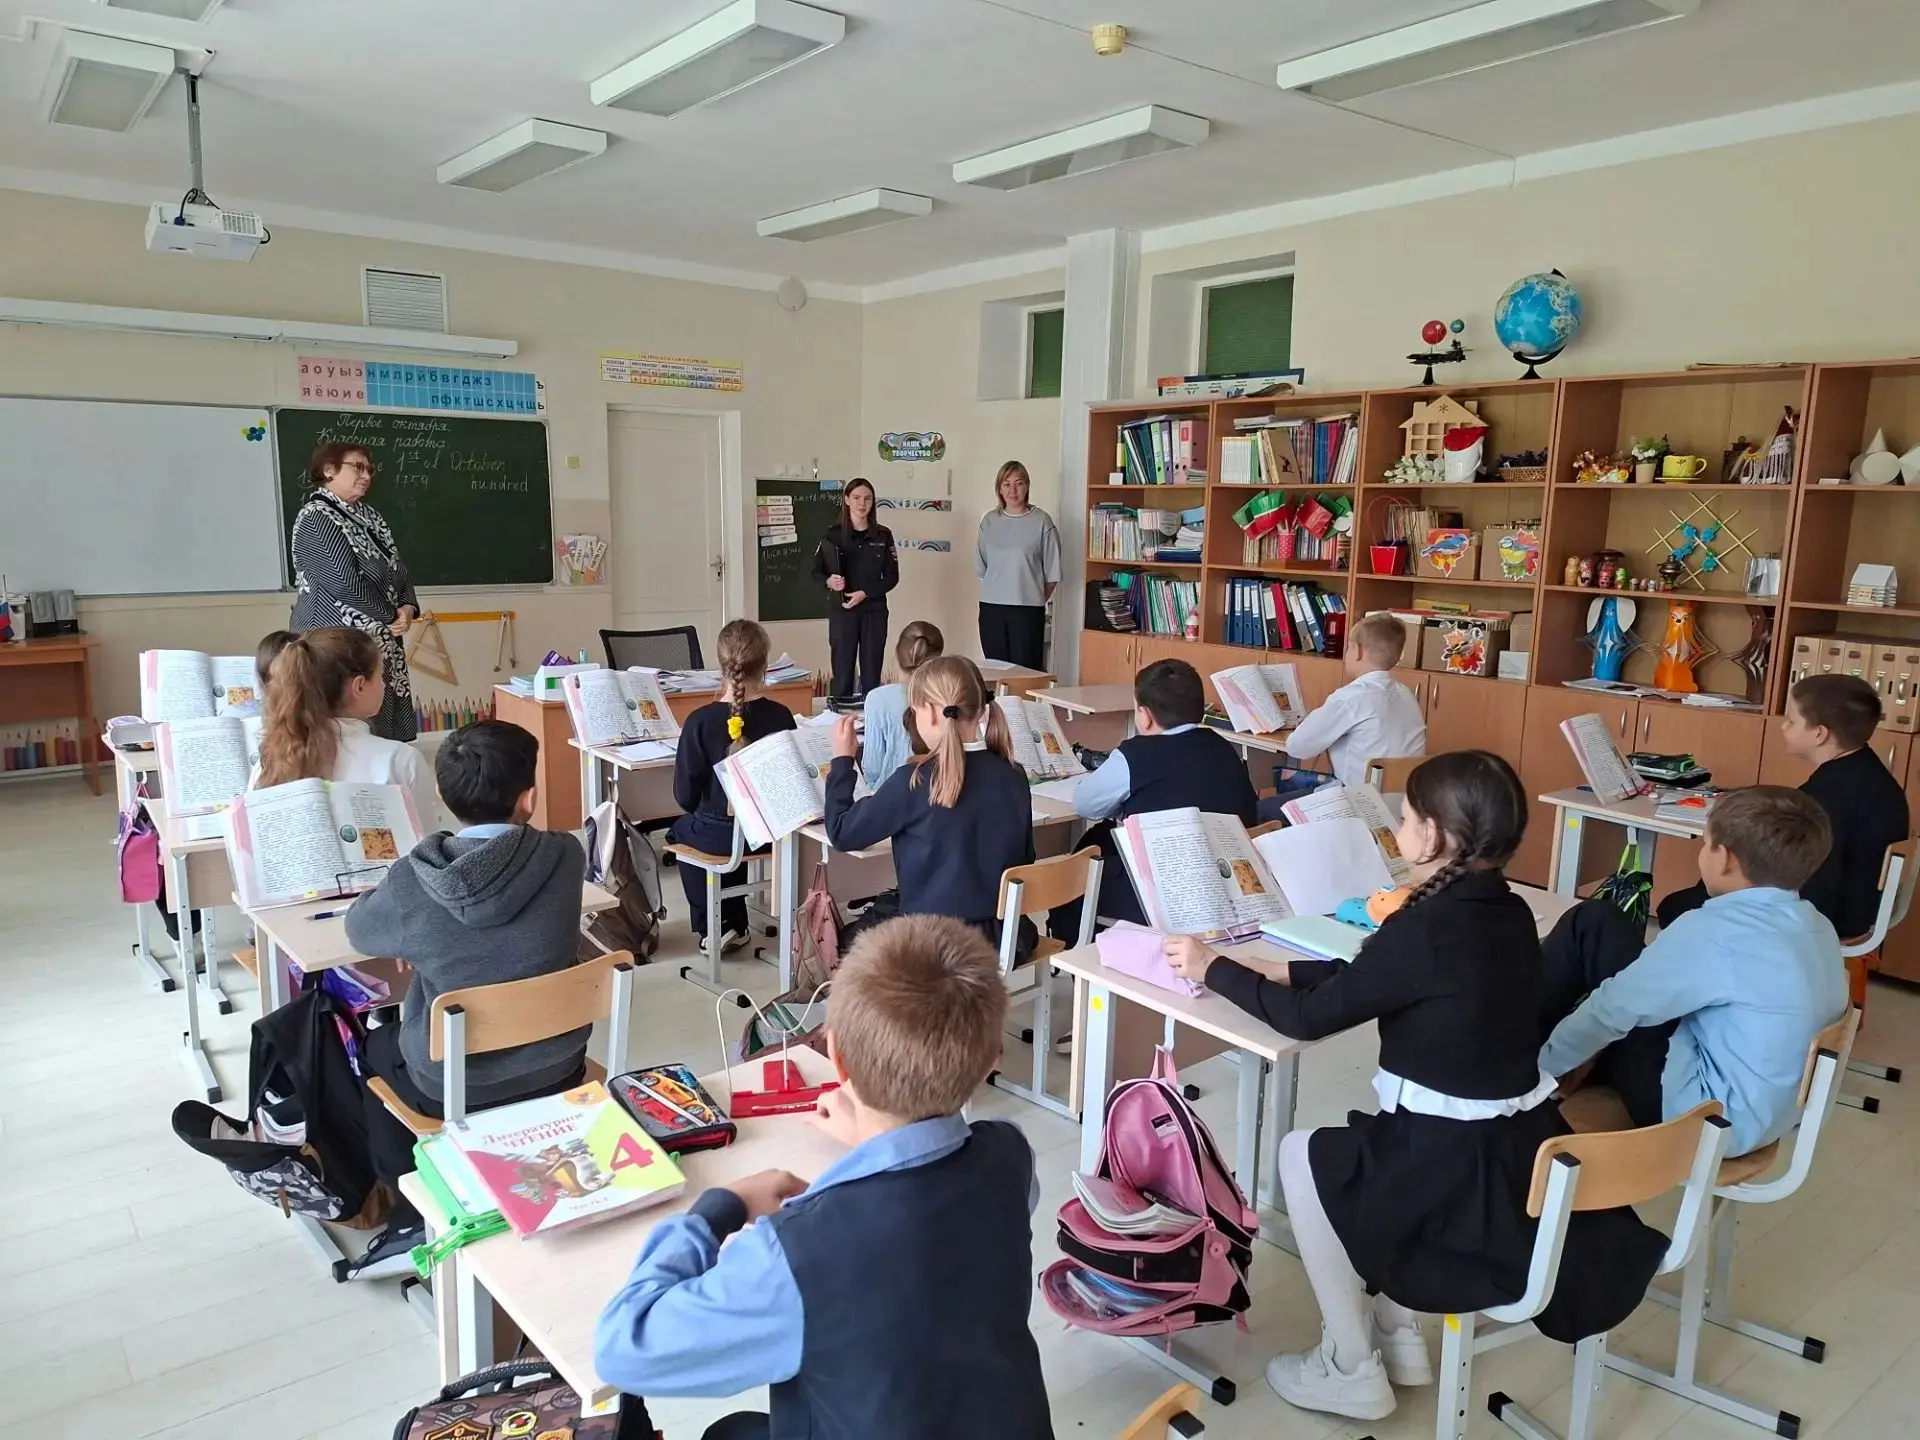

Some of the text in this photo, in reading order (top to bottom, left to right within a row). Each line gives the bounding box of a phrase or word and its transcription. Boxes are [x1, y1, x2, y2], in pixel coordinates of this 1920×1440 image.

[336, 413, 382, 436] Первое
[891, 449, 931, 457] ТВОРЧЕСТВО
[902, 440, 920, 448] НАШЕ
[471, 472, 528, 493] hundred
[503, 1123, 578, 1147] ЧТЕНИЕ
[610, 1132, 654, 1173] 4
